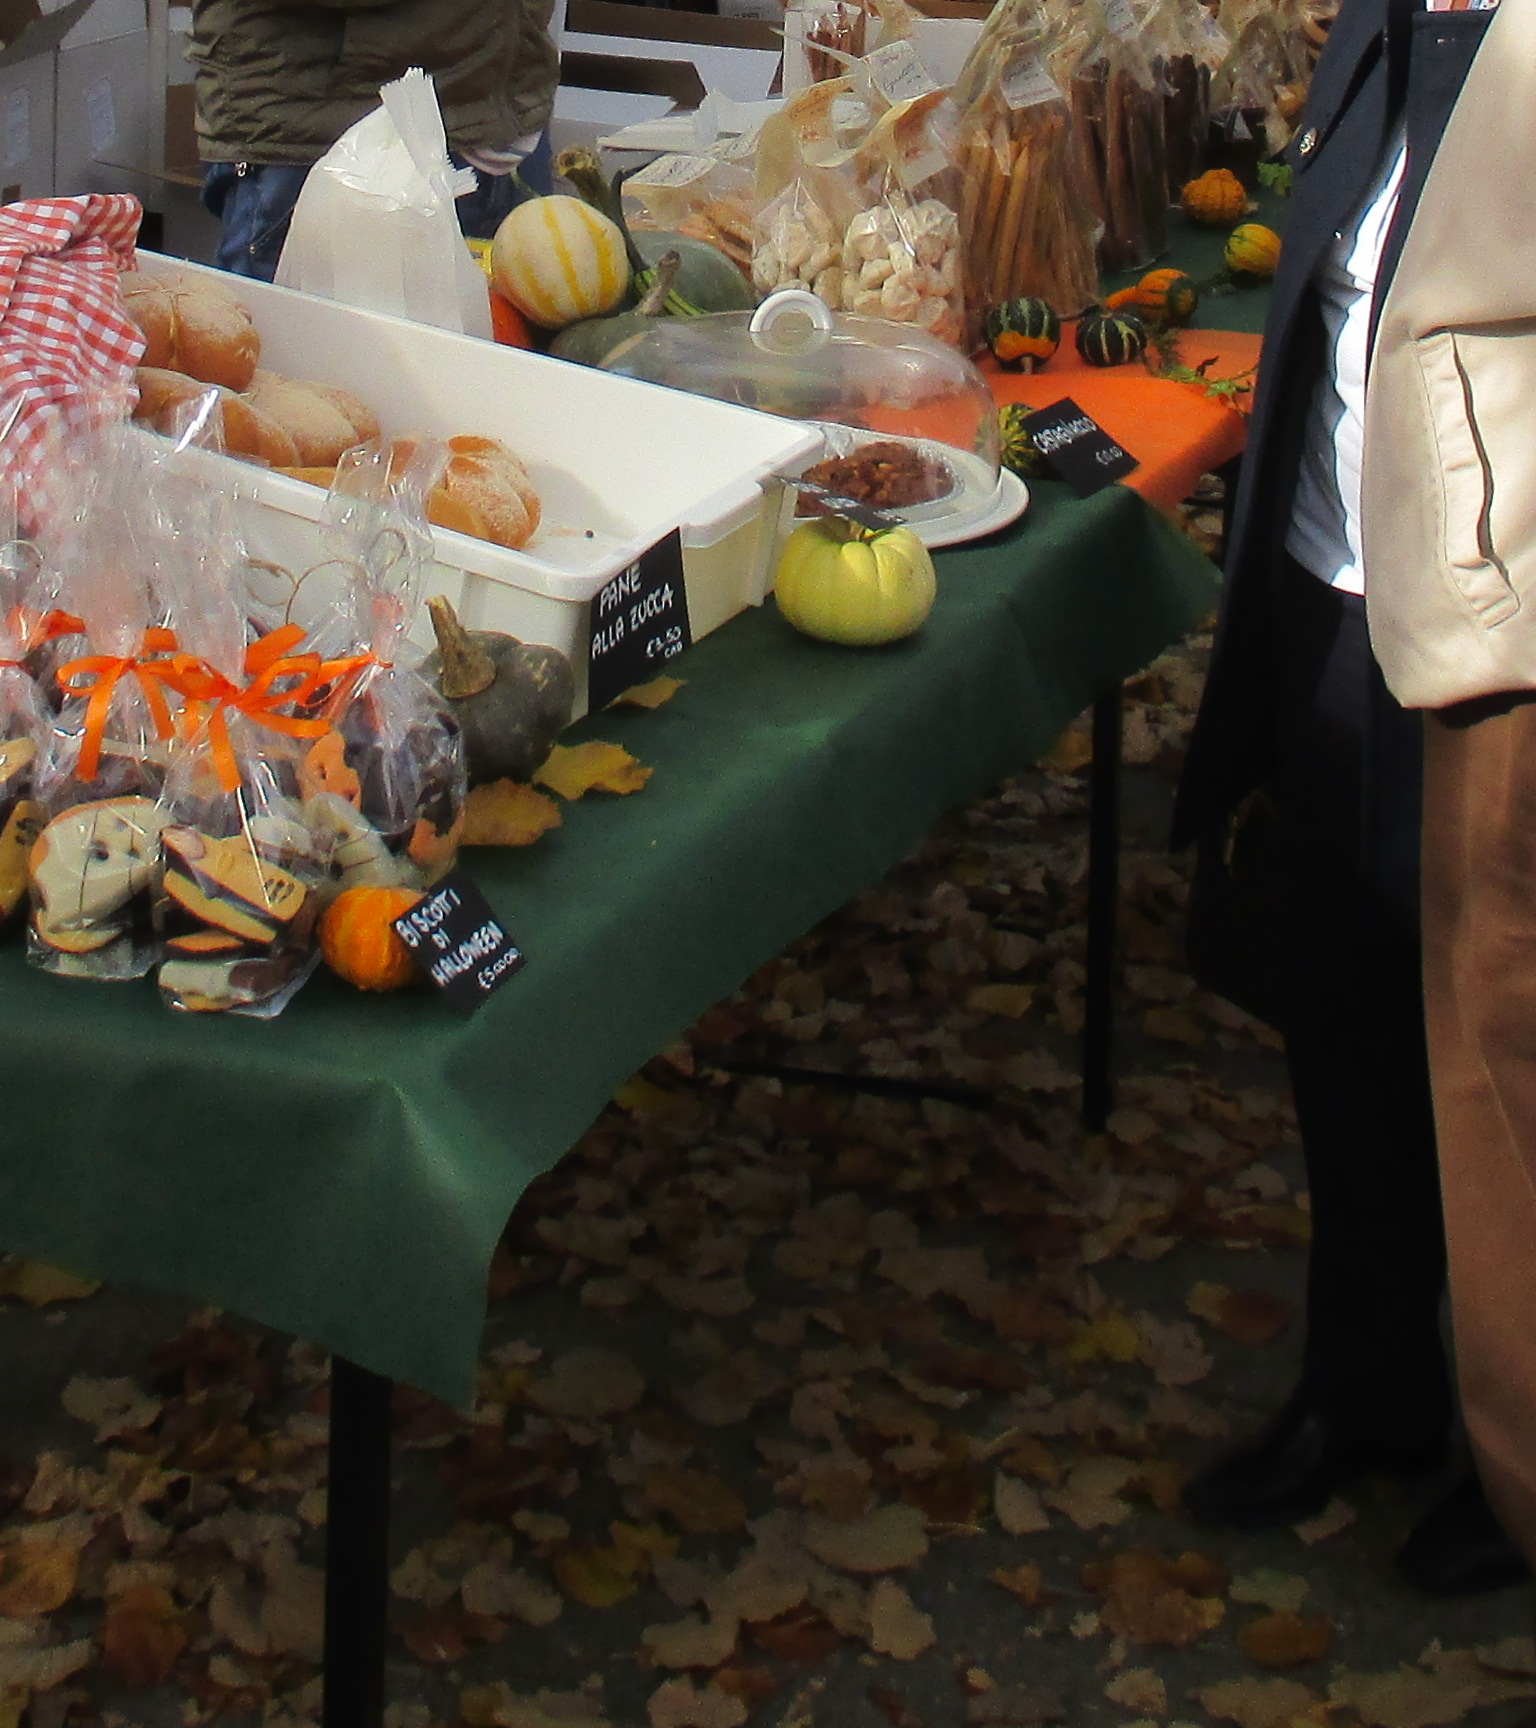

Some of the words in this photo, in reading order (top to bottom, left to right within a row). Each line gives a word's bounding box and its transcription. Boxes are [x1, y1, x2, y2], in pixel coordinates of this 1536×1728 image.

[599, 562, 642, 618] PANE
[591, 615, 625, 661] ALLA
[629, 582, 675, 633] ZUCCA
[395, 888, 463, 948] BISCOTTI
[430, 927, 452, 950] DI
[430, 920, 504, 988] HALLOWEEN
